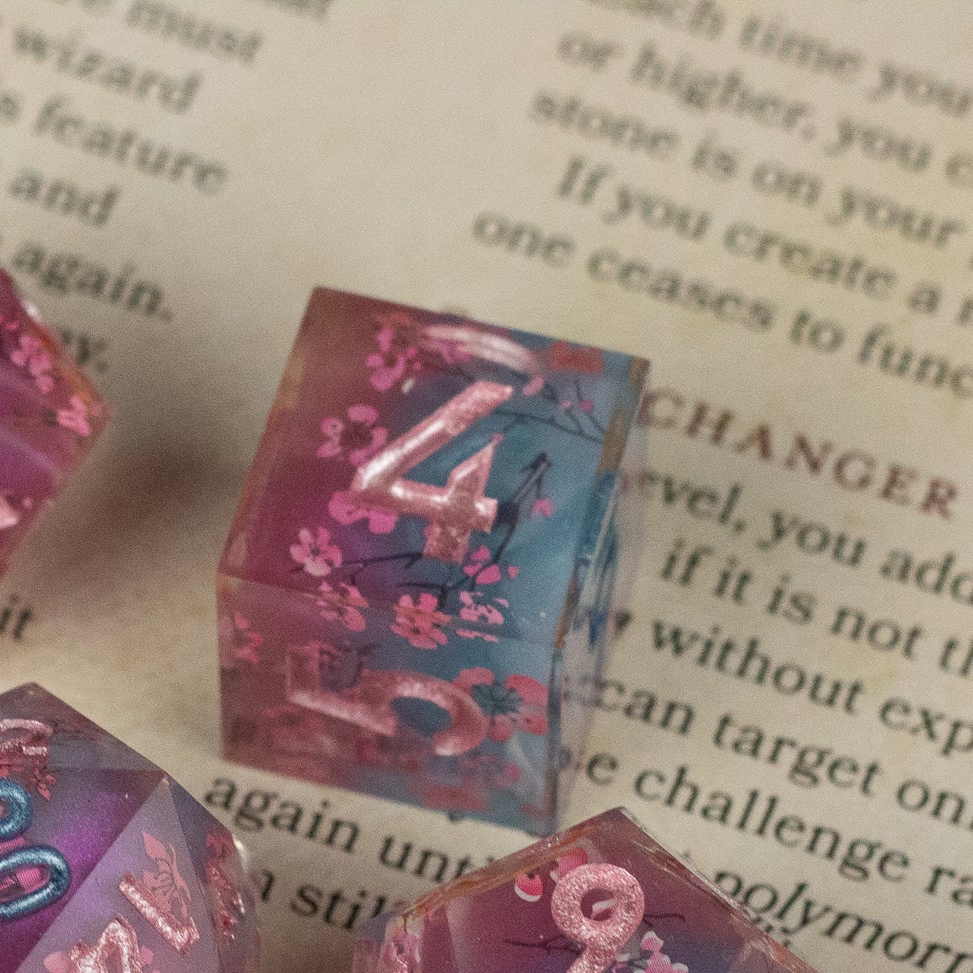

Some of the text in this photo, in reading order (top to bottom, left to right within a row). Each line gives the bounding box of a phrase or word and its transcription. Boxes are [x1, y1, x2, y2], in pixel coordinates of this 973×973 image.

[12, 24, 205, 115] wizard
[737, 16, 867, 80] time
[33, 96, 228, 192] feature
[555, 32, 623, 72] or
[630, 42, 819, 142] higher,
[823, 116, 935, 174] you
[9, 172, 121, 229] and
[531, 90, 965, 249] stone is on your
[12, 242, 175, 324] again.
[471, 212, 577, 268] one
[586, 250, 777, 333] ceases
[789, 310, 847, 355] to
[557, 156, 615, 206] If
[602, 187, 713, 243] you
[723, 222, 899, 298] create
[907, 284, 944, 317] a
[355, 378, 515, 564] 4
[756, 511, 868, 569] you
[659, 537, 715, 588] if
[713, 556, 755, 606] it
[765, 573, 817, 625] is
[828, 606, 925, 661] not
[651, 619, 866, 716] without
[713, 714, 885, 798] target
[202, 773, 362, 857] again
[634, 765, 912, 882] challenge
